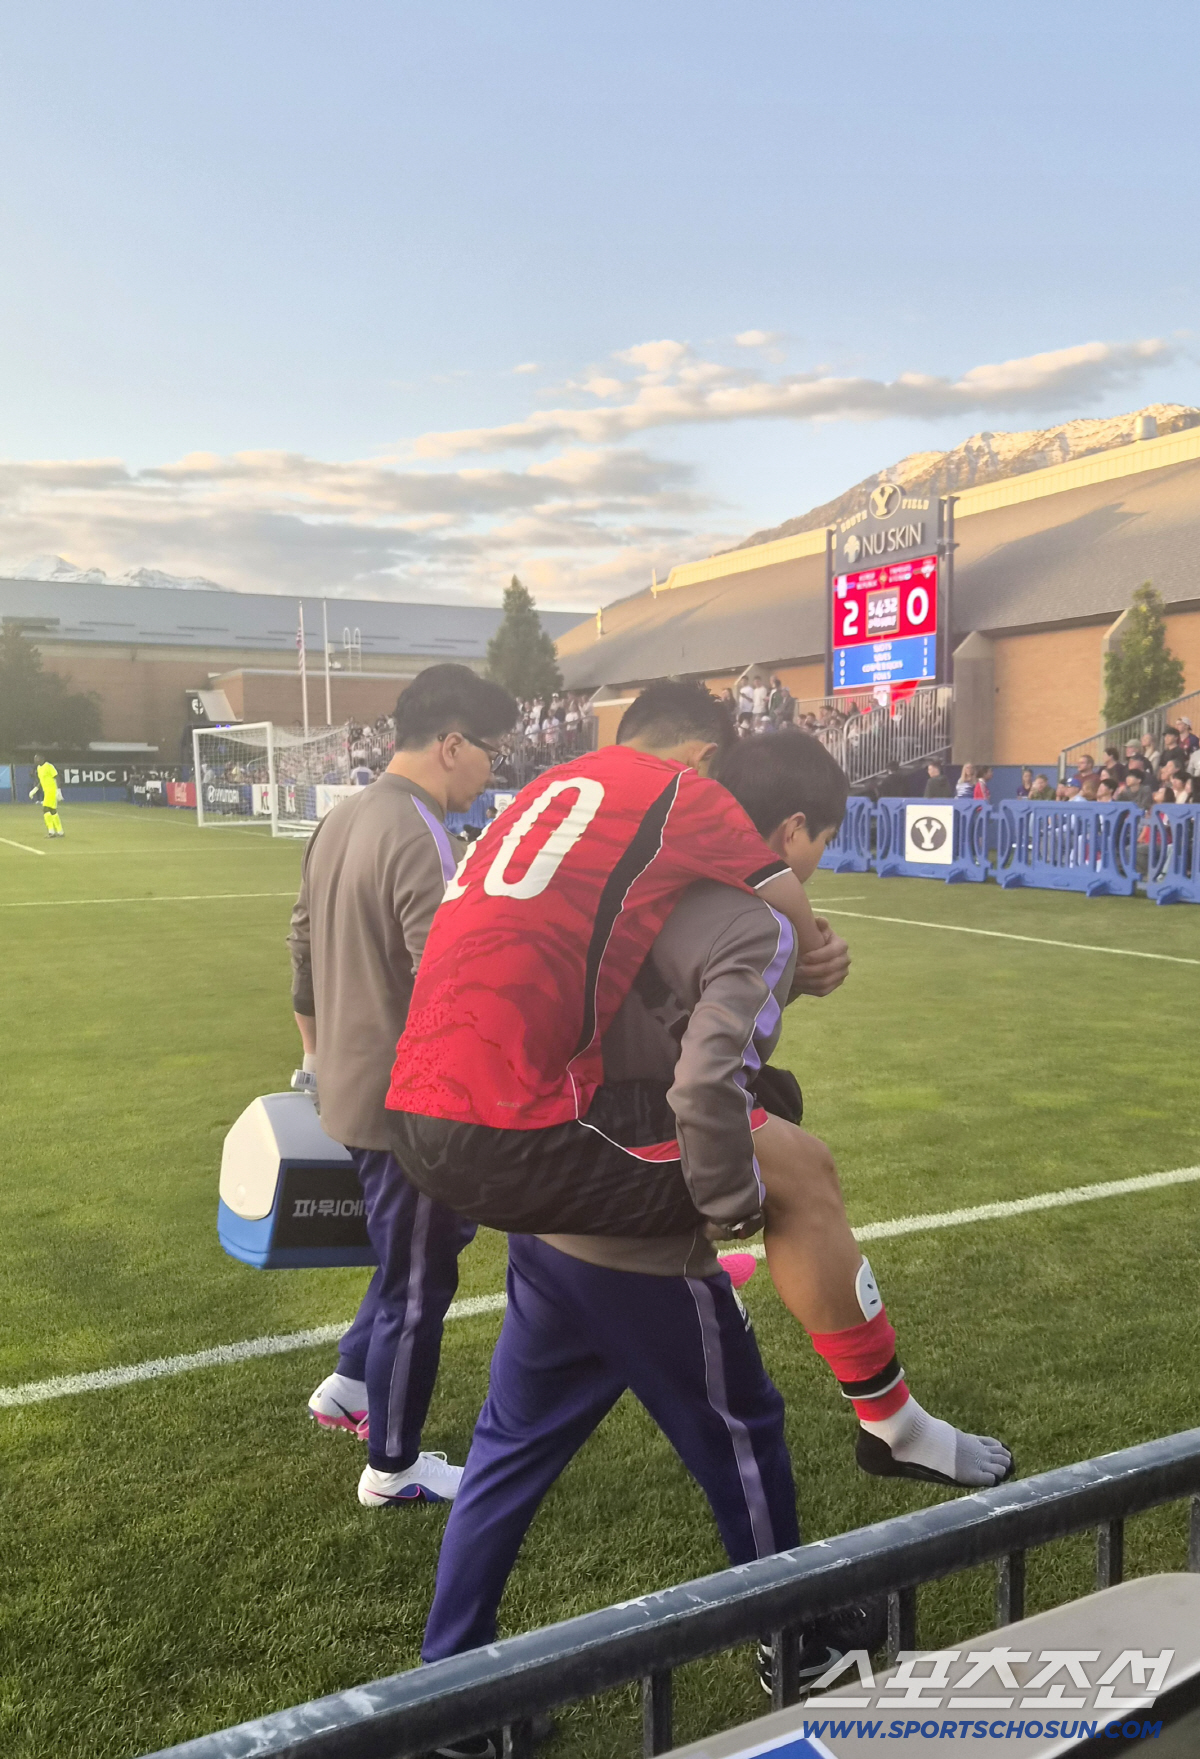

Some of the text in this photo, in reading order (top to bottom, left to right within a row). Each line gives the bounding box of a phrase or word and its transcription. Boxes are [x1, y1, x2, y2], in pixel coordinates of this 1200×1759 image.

[840, 498, 930, 533] SOUTH FIELD
[862, 522, 922, 558] NU SKIN
[843, 600, 859, 636] 2
[906, 586, 929, 626] 0
[82, 770, 116, 782] HDC
[214, 788, 239, 803] HYUNDAI
[292, 1199, 367, 1217] 파워에
